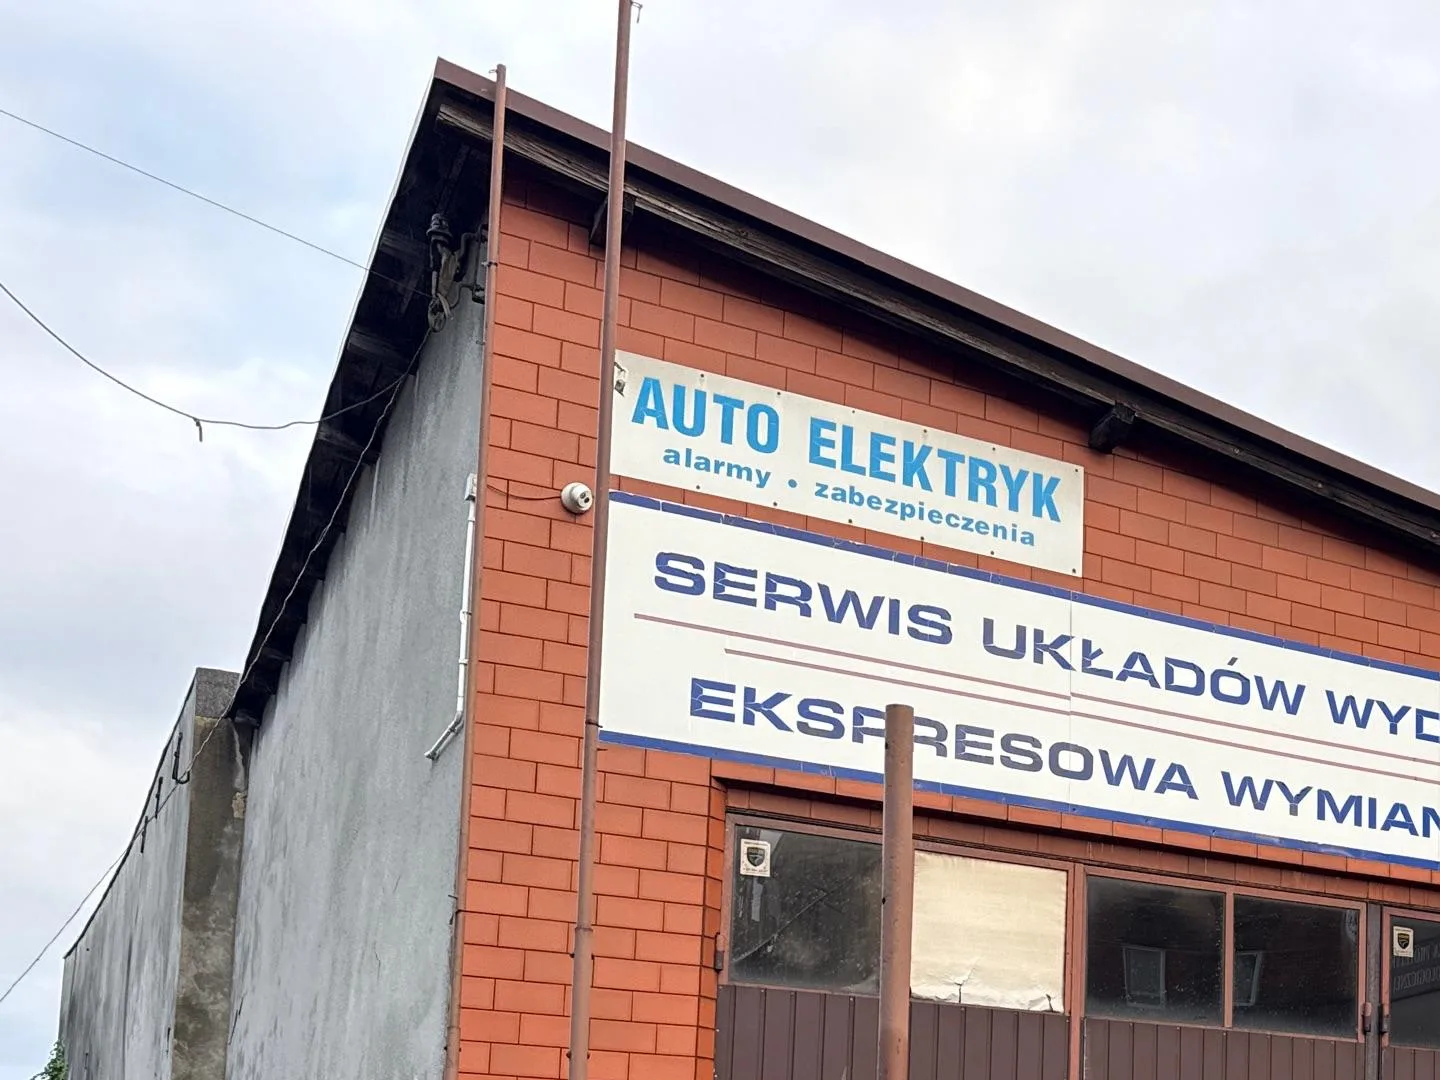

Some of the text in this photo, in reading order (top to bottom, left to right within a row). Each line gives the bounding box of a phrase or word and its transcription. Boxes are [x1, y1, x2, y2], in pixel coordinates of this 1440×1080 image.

[630, 377, 1062, 523] AUTO ELEKTRYK
[663, 447, 1036, 547] alarmy zabezpieczenia
[654, 551, 953, 645] SERWIS
[982, 617, 1306, 716] UKŁADÓW
[690, 677, 1199, 801] EKSPRESOWA
